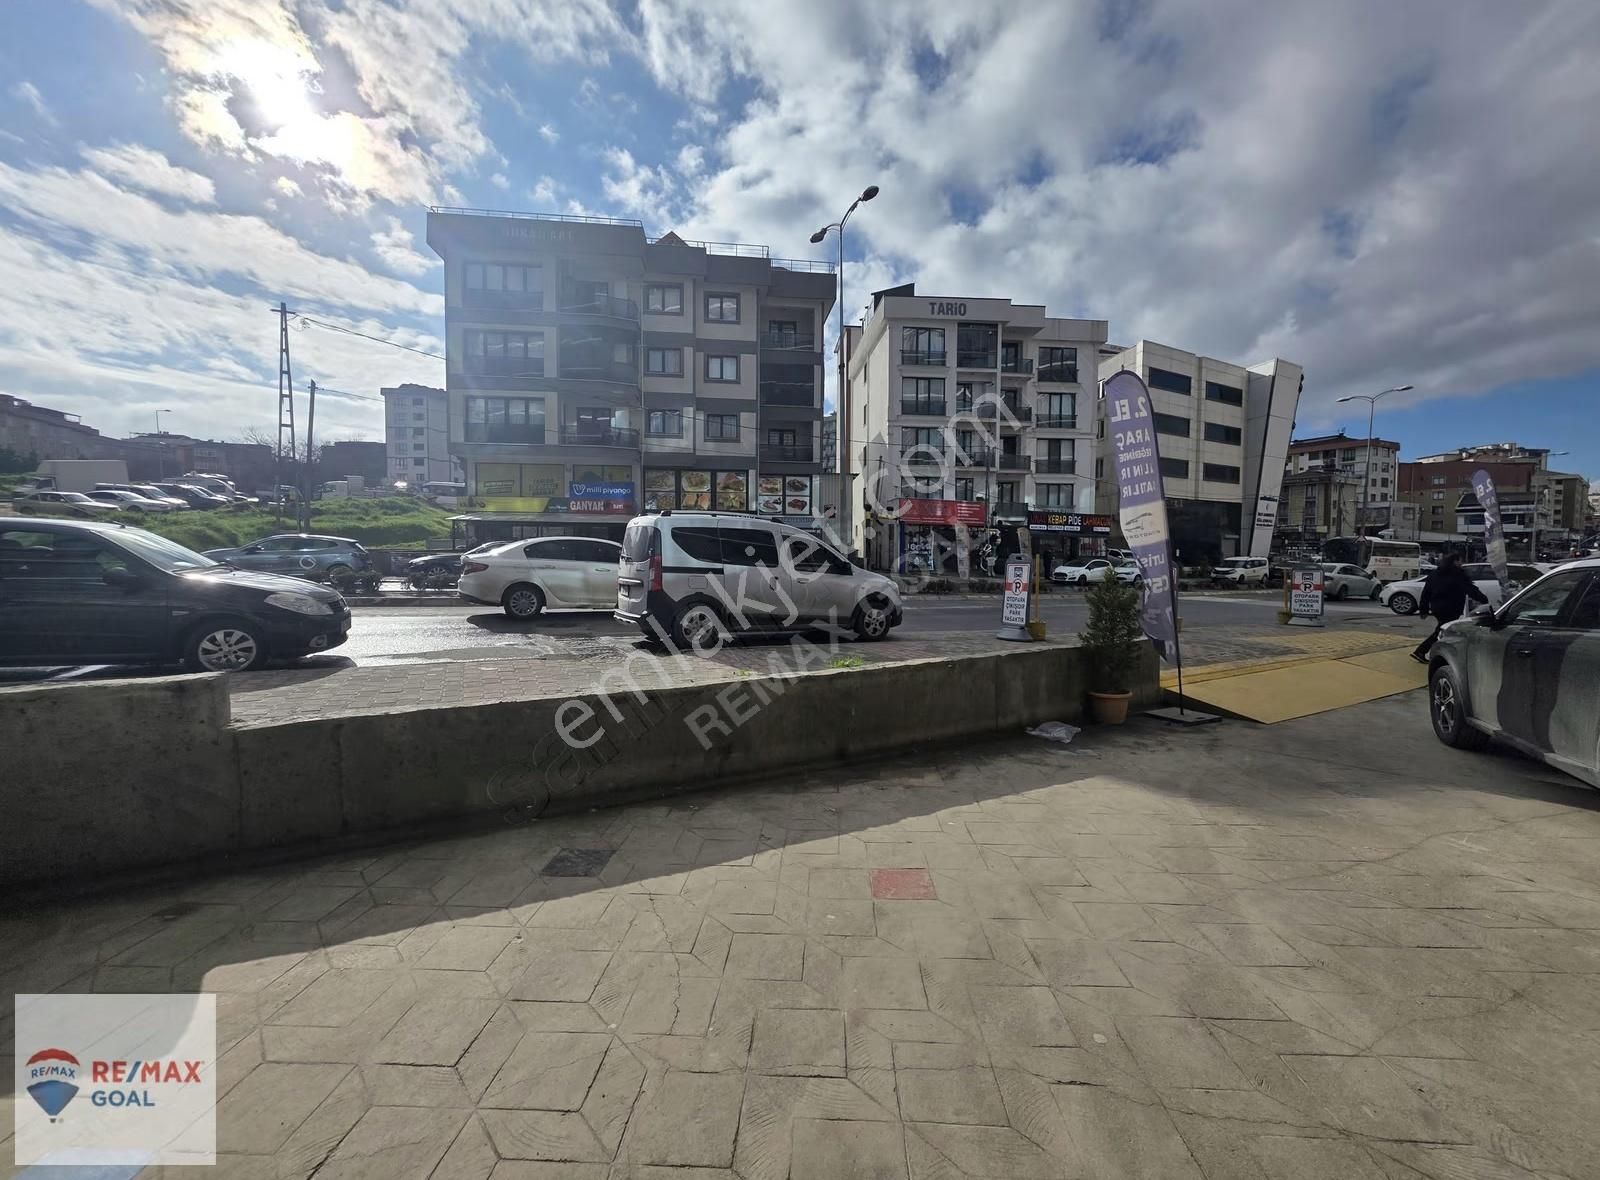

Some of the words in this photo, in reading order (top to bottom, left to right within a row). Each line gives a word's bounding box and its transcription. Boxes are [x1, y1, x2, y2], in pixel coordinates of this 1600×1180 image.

[603, 487, 631, 495] piyango
[570, 500, 604, 511] GANYAN
[1048, 514, 1067, 525] KEBAP
